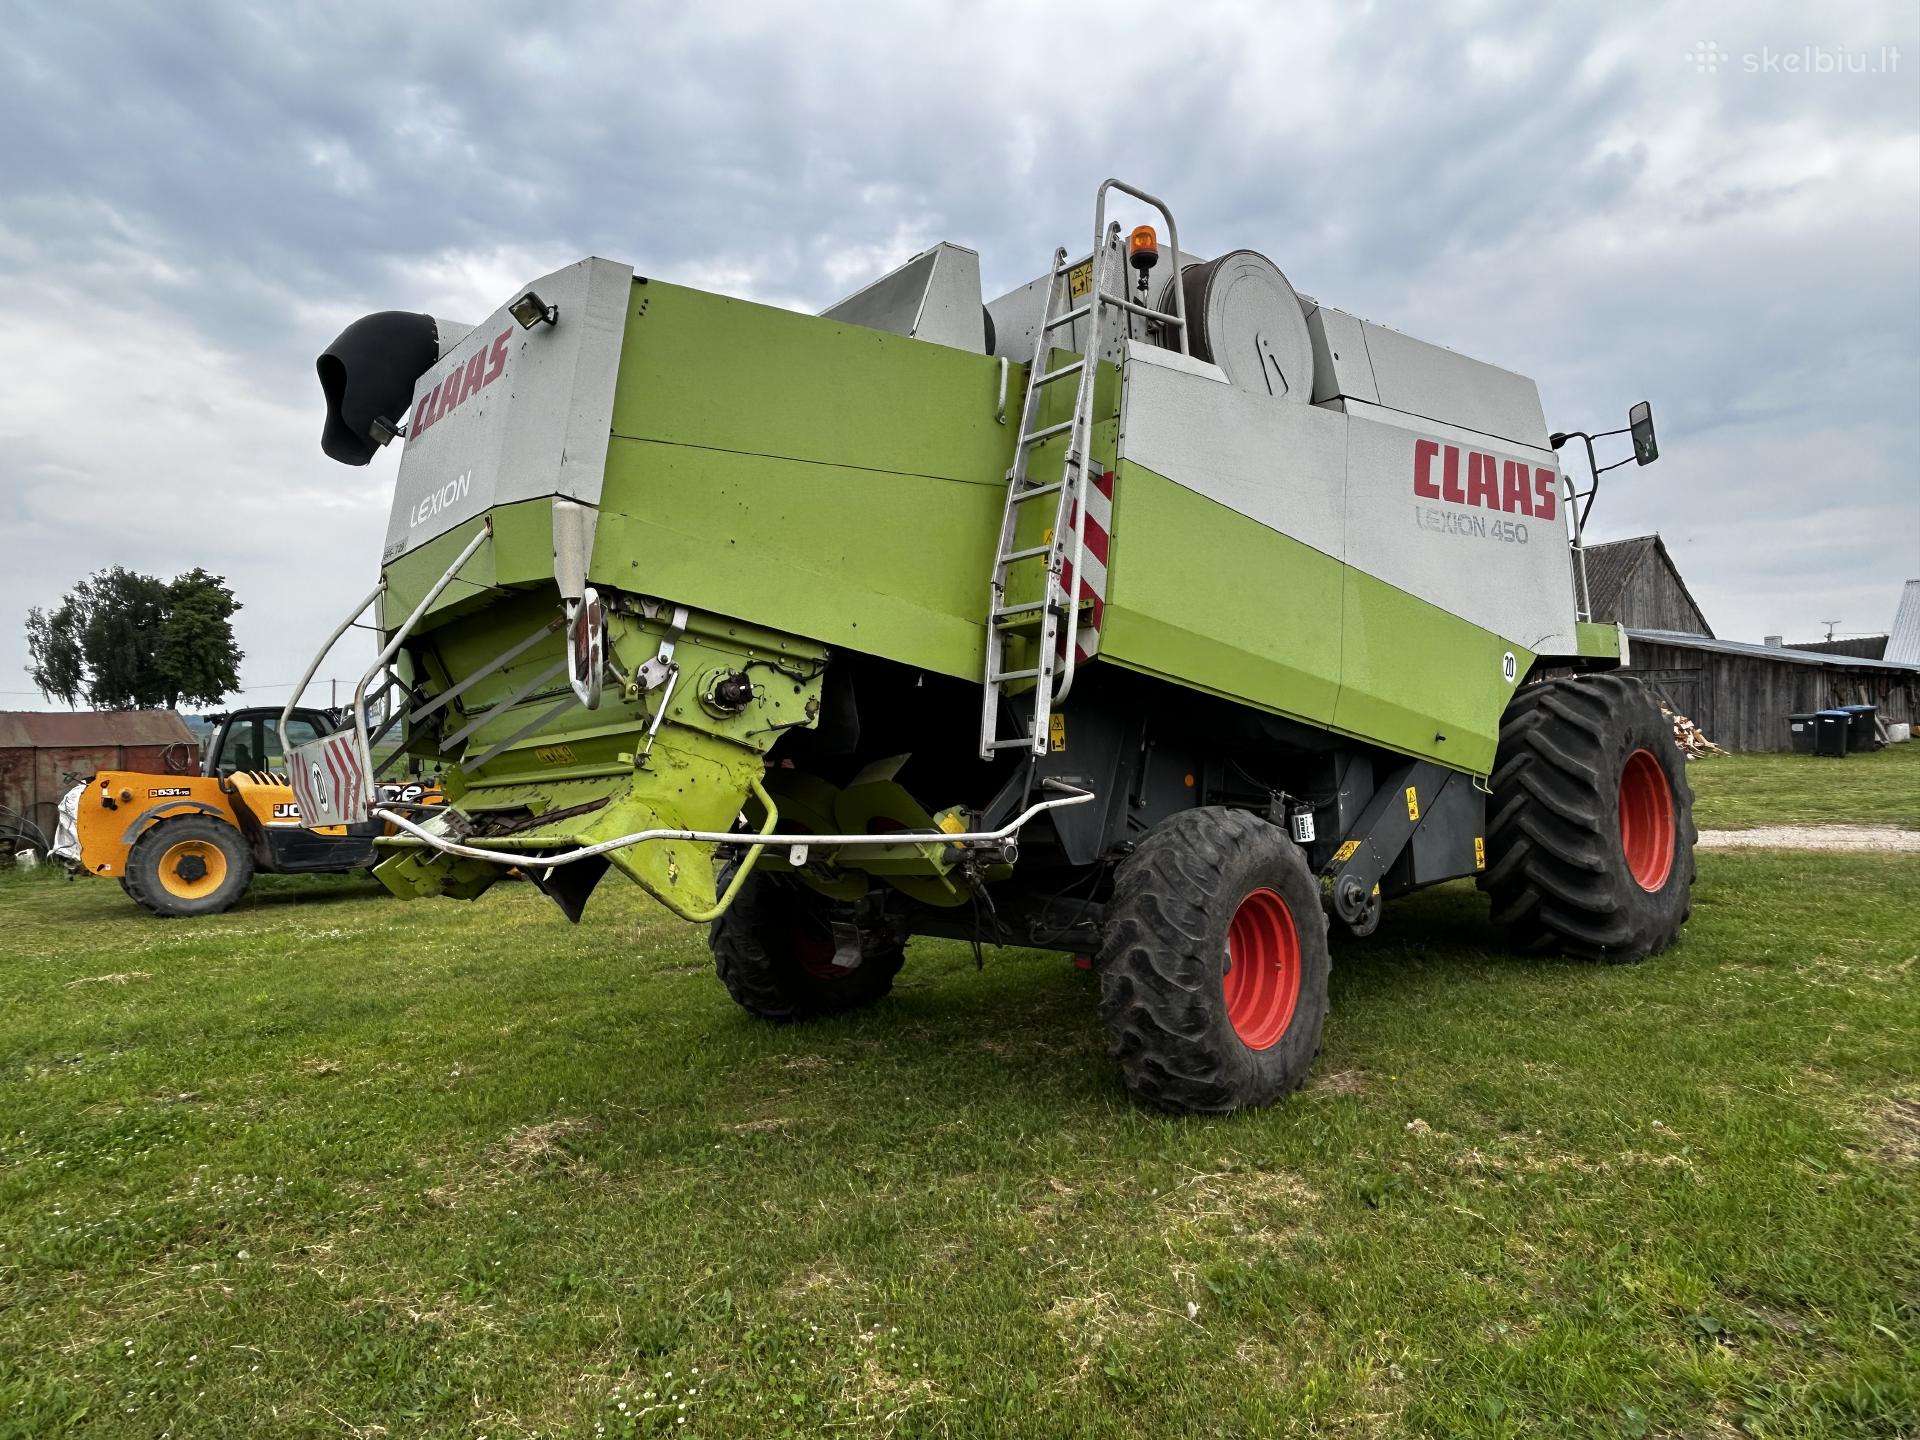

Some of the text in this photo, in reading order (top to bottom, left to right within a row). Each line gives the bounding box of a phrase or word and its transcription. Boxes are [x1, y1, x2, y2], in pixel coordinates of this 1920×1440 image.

[409, 325, 514, 442] CLAAS
[410, 469, 472, 529] LEXION
[1413, 438, 1556, 521] CLAAS
[1415, 505, 1529, 544] LEXION 450
[1504, 655, 1514, 678] 20
[274, 803, 301, 818] JC
